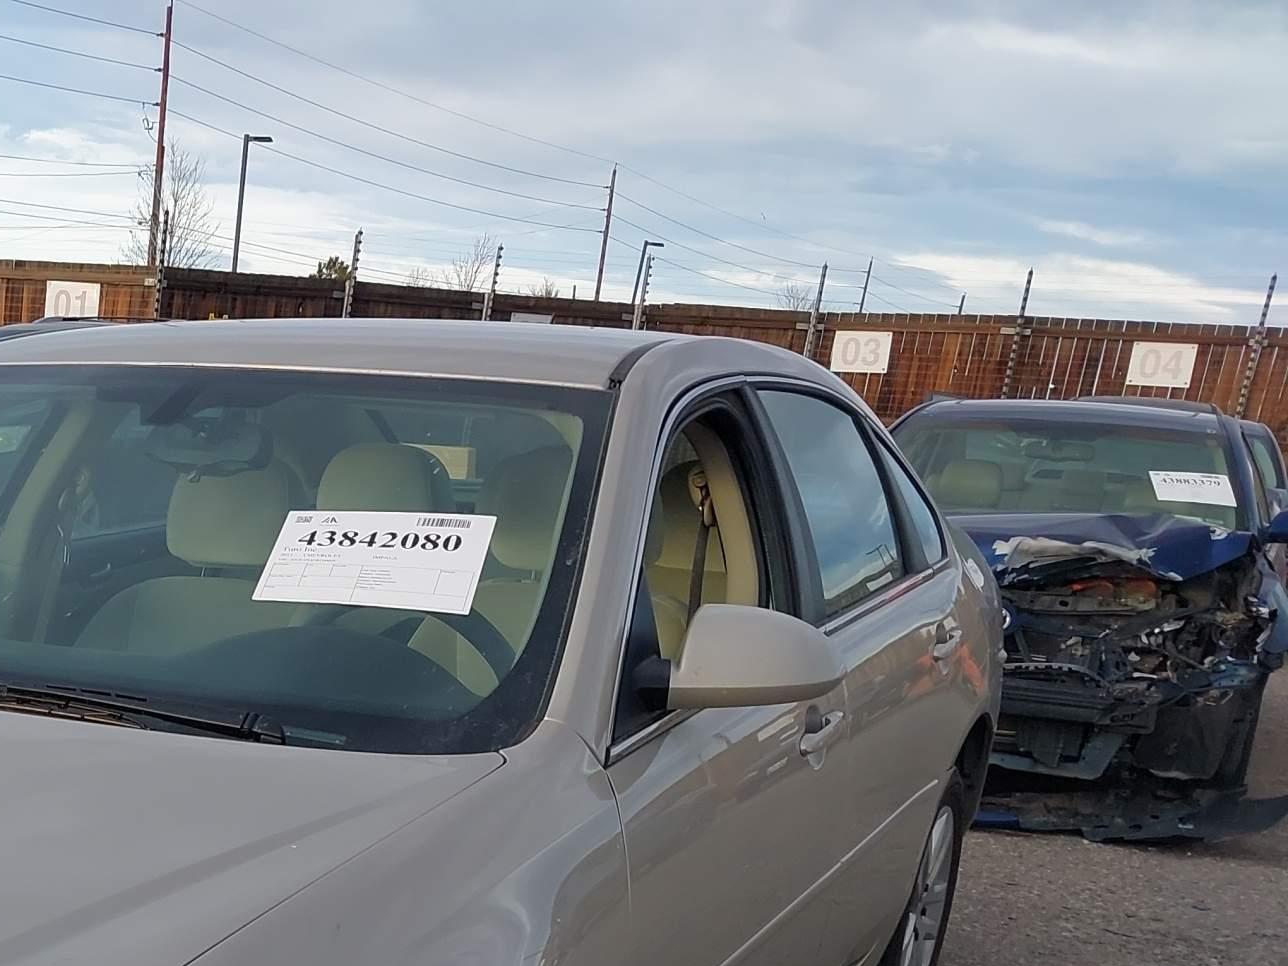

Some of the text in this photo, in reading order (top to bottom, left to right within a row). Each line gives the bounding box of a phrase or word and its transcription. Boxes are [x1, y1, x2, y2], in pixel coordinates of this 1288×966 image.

[54, 289, 87, 316] 01
[842, 337, 881, 366] 03
[1139, 349, 1184, 379] 04
[298, 530, 462, 552] 43842080
